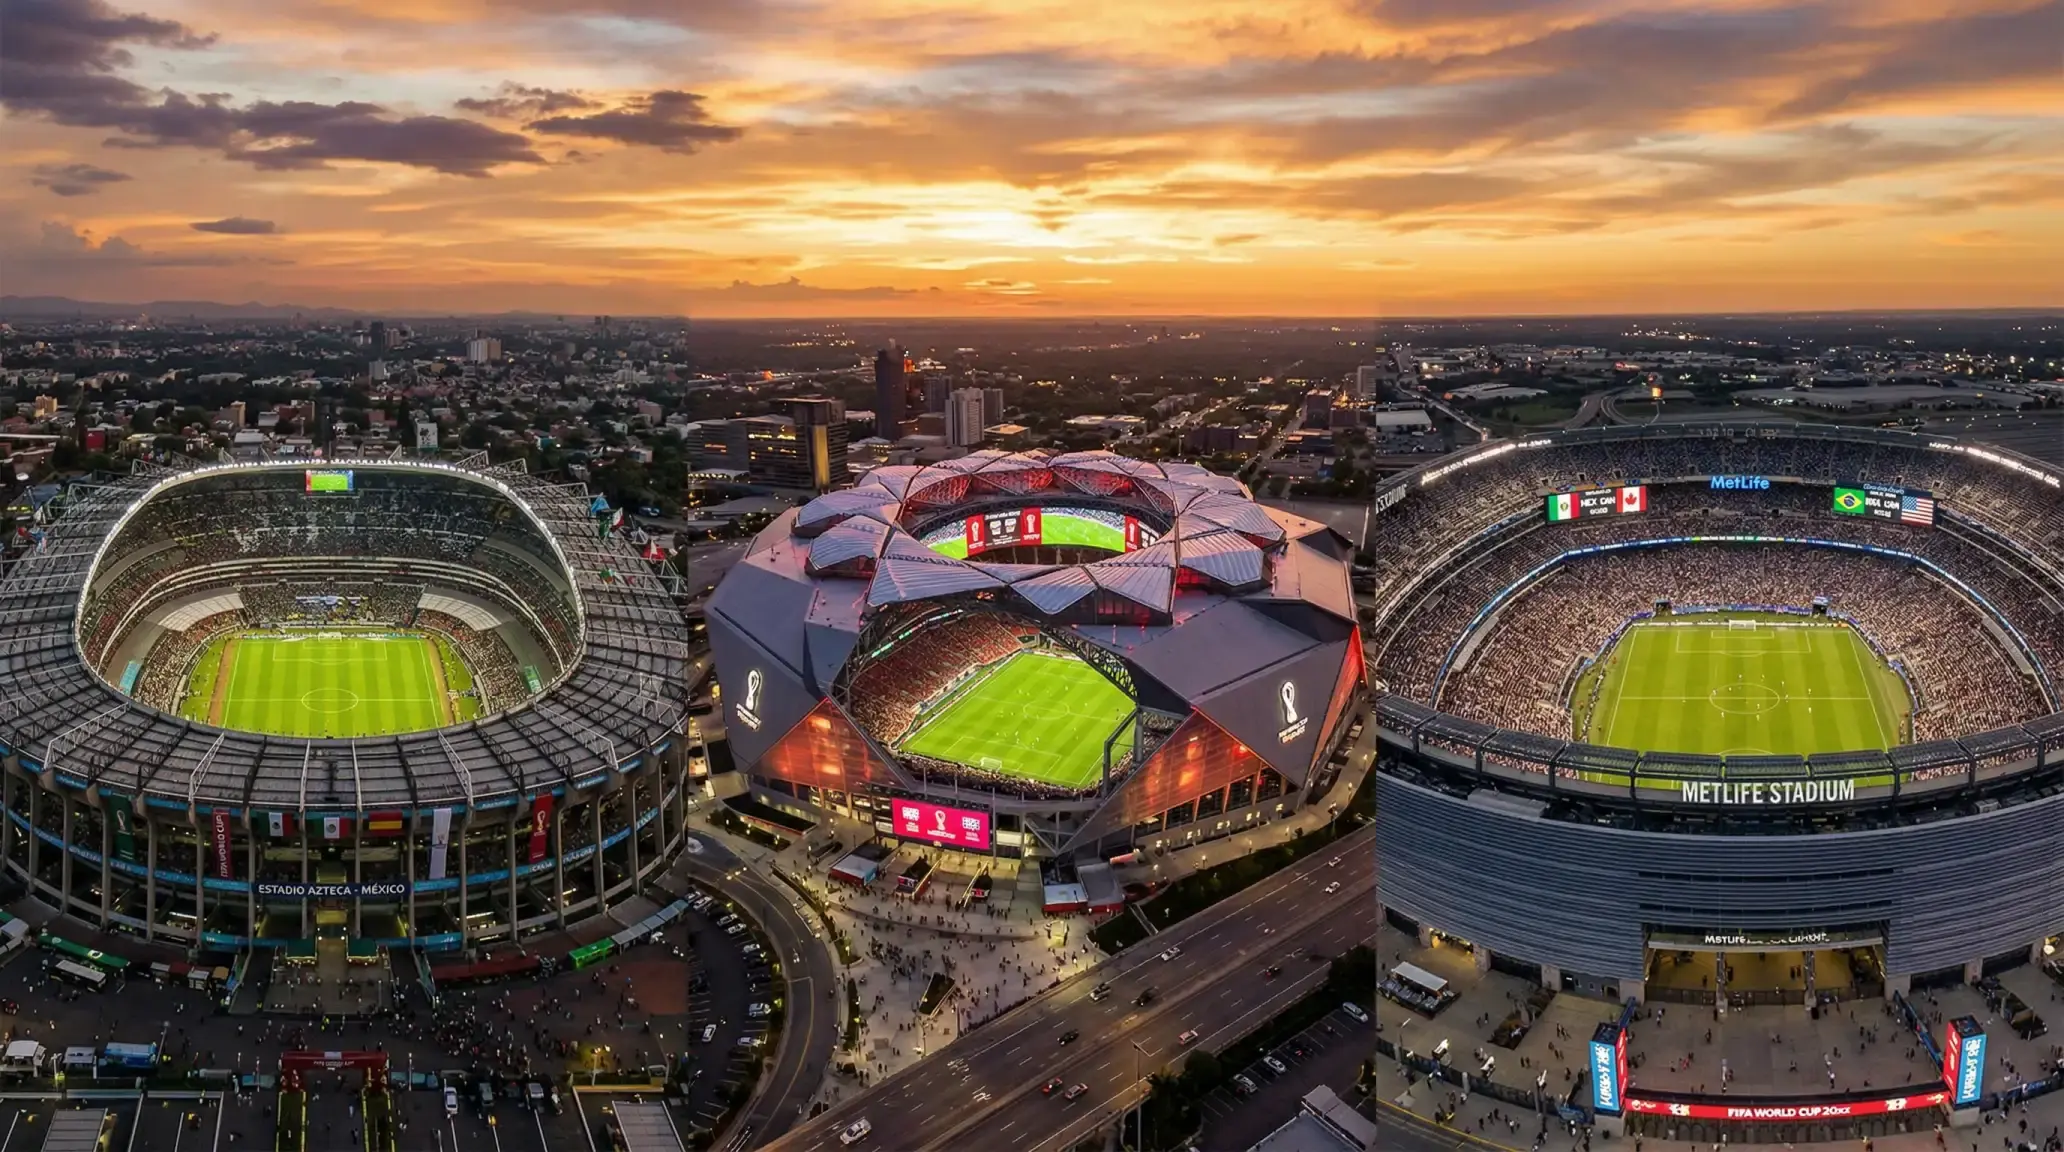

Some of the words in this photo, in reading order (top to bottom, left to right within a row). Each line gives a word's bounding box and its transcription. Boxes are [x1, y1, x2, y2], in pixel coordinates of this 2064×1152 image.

[1710, 475, 1770, 490] MetLife
[1682, 780, 1764, 804] METLIFE
[1769, 779, 1855, 804] STADIUM
[258, 884, 305, 896] ESTADIO
[307, 885, 352, 896] AZTECA
[361, 881, 405, 895] MÉXICO
[1727, 1107, 1753, 1117] FIFA
[1754, 1107, 1796, 1117] WORLD
[1798, 1106, 1821, 1116] CUP
